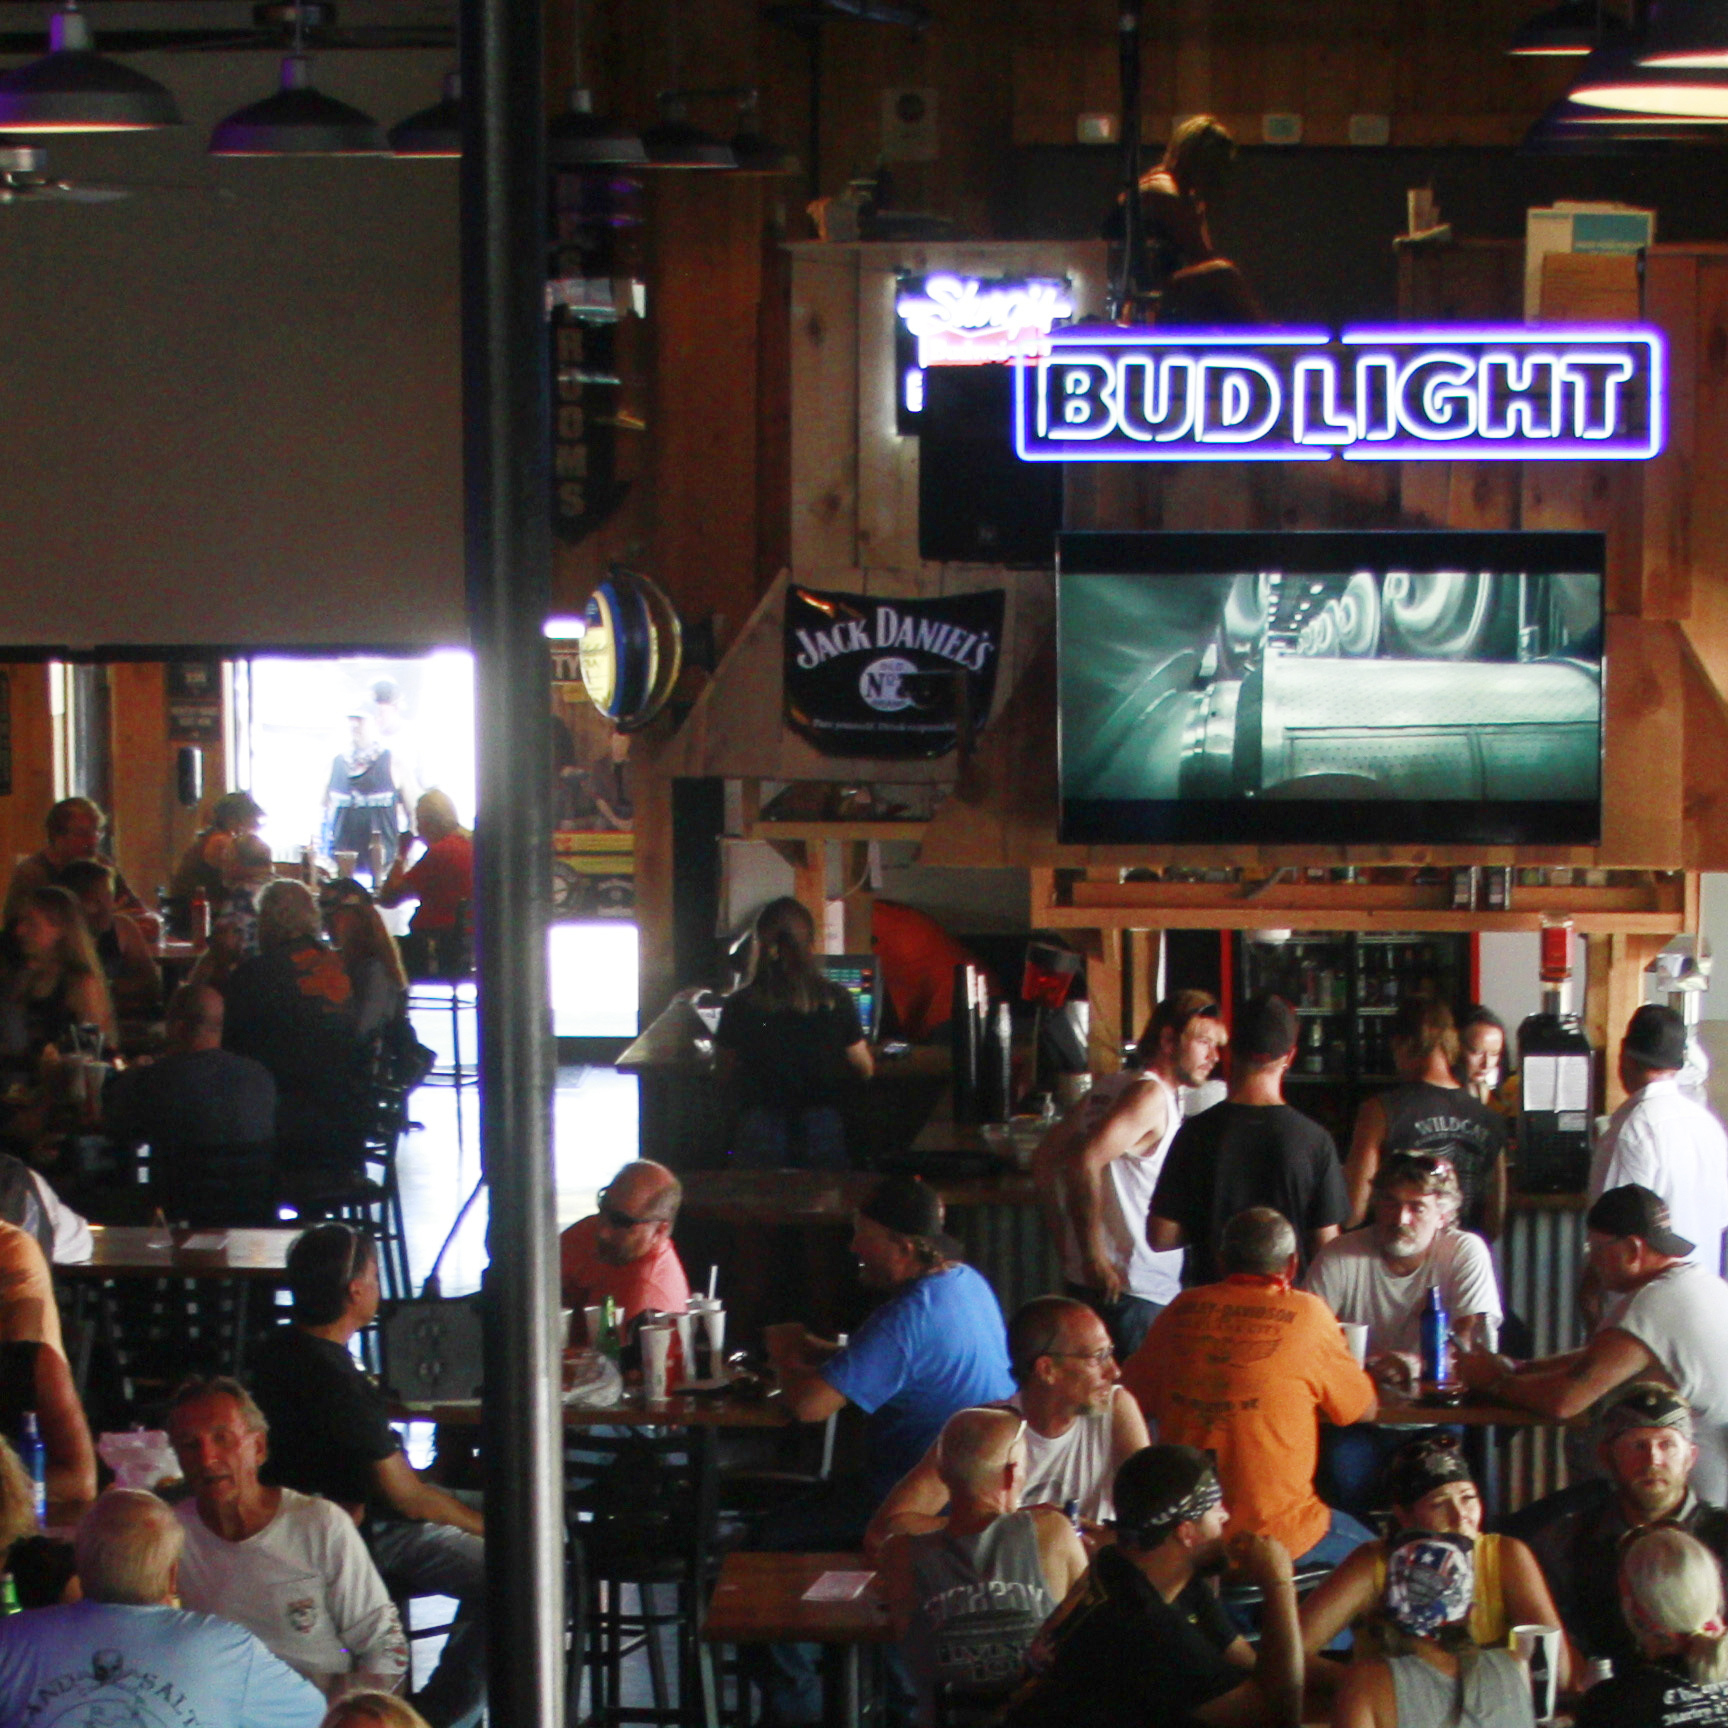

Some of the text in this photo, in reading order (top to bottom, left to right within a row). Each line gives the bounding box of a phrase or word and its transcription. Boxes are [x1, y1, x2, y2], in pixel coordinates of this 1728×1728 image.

[1038, 352, 1633, 446] BUD LIGHT
[795, 606, 995, 671] JACK DANIEL'S
